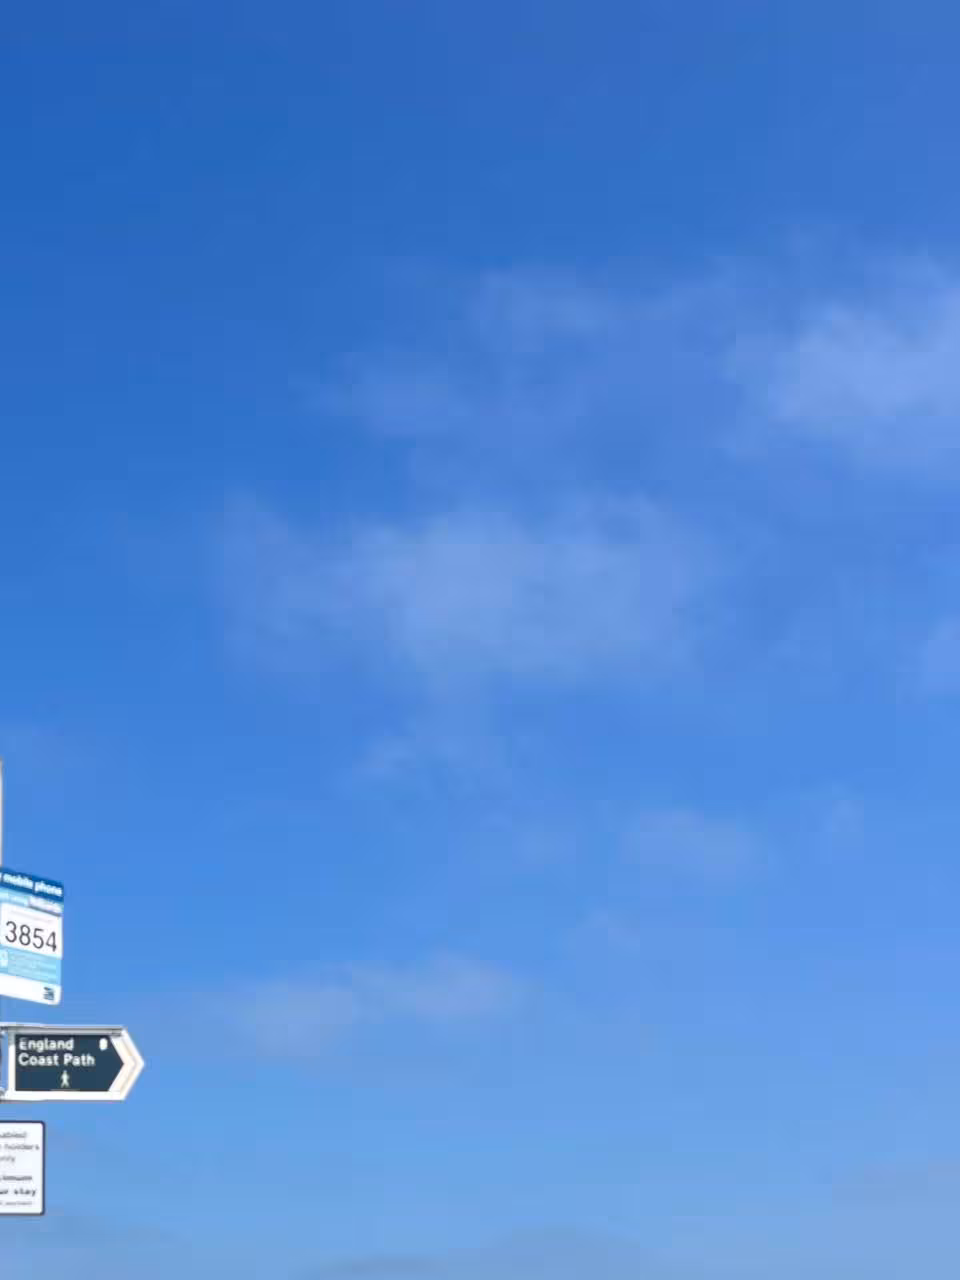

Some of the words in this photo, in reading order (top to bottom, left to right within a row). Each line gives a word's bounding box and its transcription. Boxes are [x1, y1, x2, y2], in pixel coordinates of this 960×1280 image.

[3, 873, 34, 888] mobile
[35, 881, 62, 896] phone
[5, 920, 56, 952] 3854
[19, 1037, 74, 1053] England
[19, 1052, 58, 1066] Coast
[63, 1052, 95, 1066] Path
[14, 1187, 36, 1197] stay
